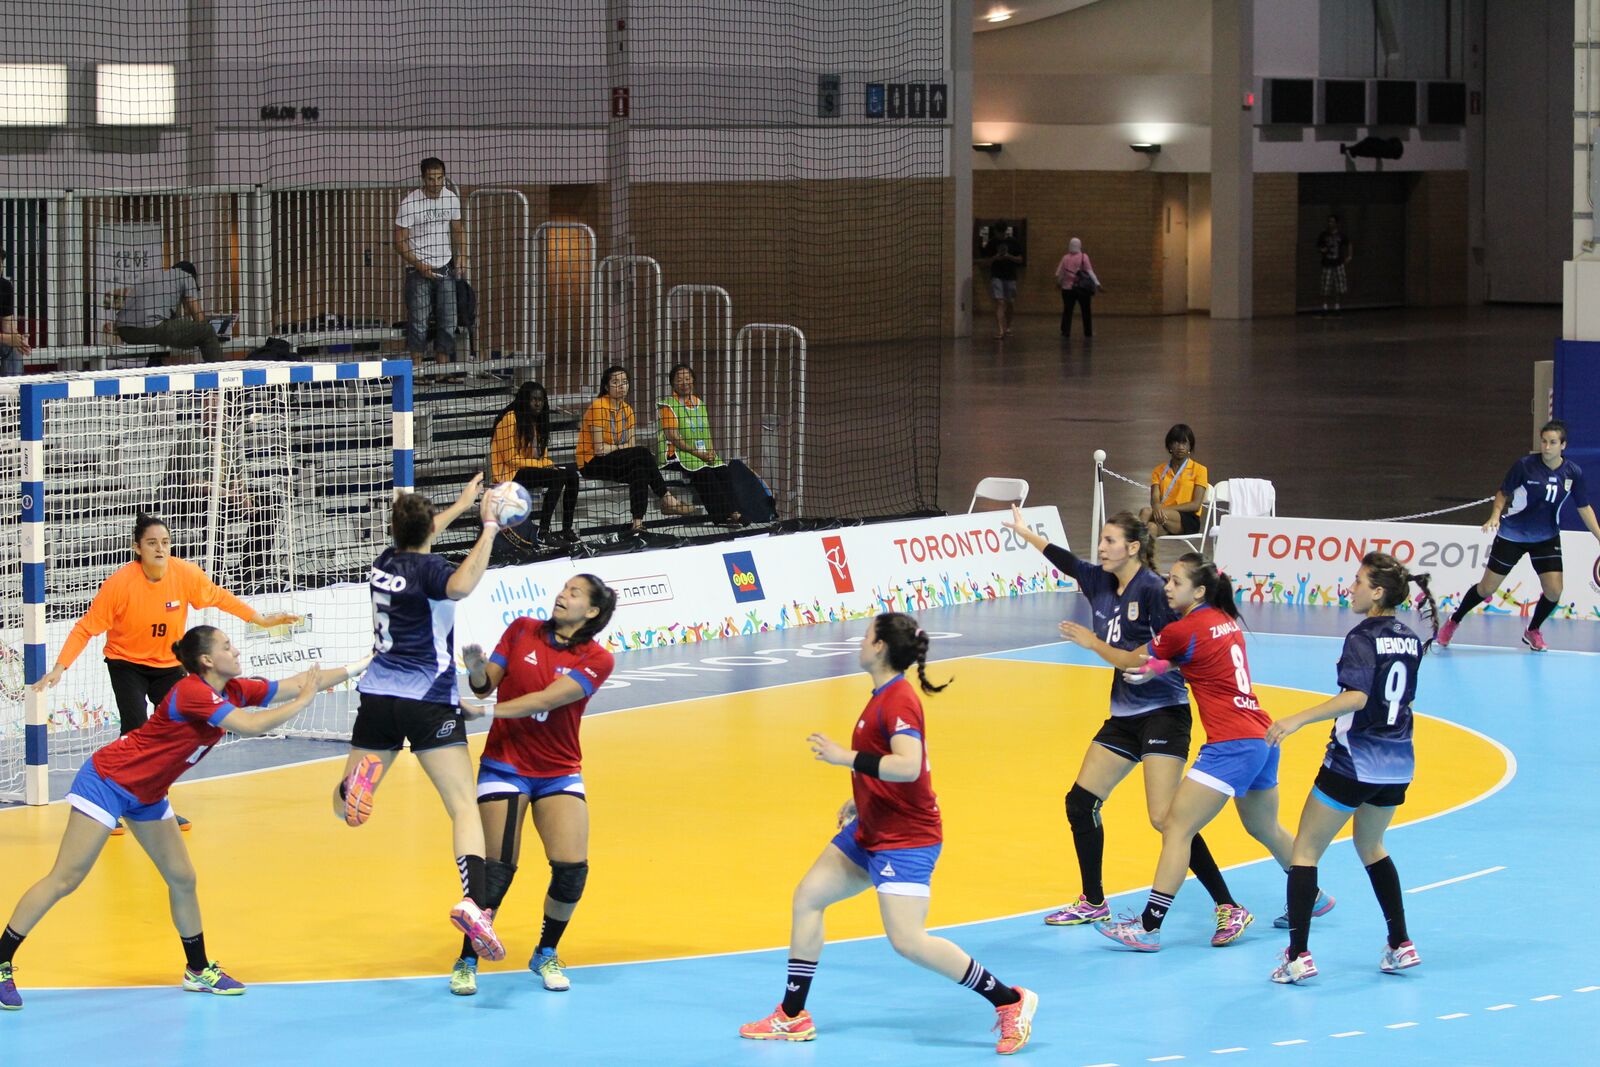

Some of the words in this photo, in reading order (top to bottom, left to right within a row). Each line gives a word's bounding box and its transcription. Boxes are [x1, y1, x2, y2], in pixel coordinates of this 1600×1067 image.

[1545, 484, 1558, 503] 11
[894, 528, 1000, 564] TORONTO
[1248, 533, 1415, 564] TORONTO
[1418, 541, 1492, 569] 201
[370, 567, 407, 592] ZZO
[623, 584, 667, 598] NATION
[733, 572, 755, 586] OLG
[151, 623, 167, 638] 19
[1106, 615, 1121, 644] 15
[250, 648, 323, 667] CHEVROLET
[1230, 644, 1250, 695] 8
[1384, 661, 1407, 725] 9
